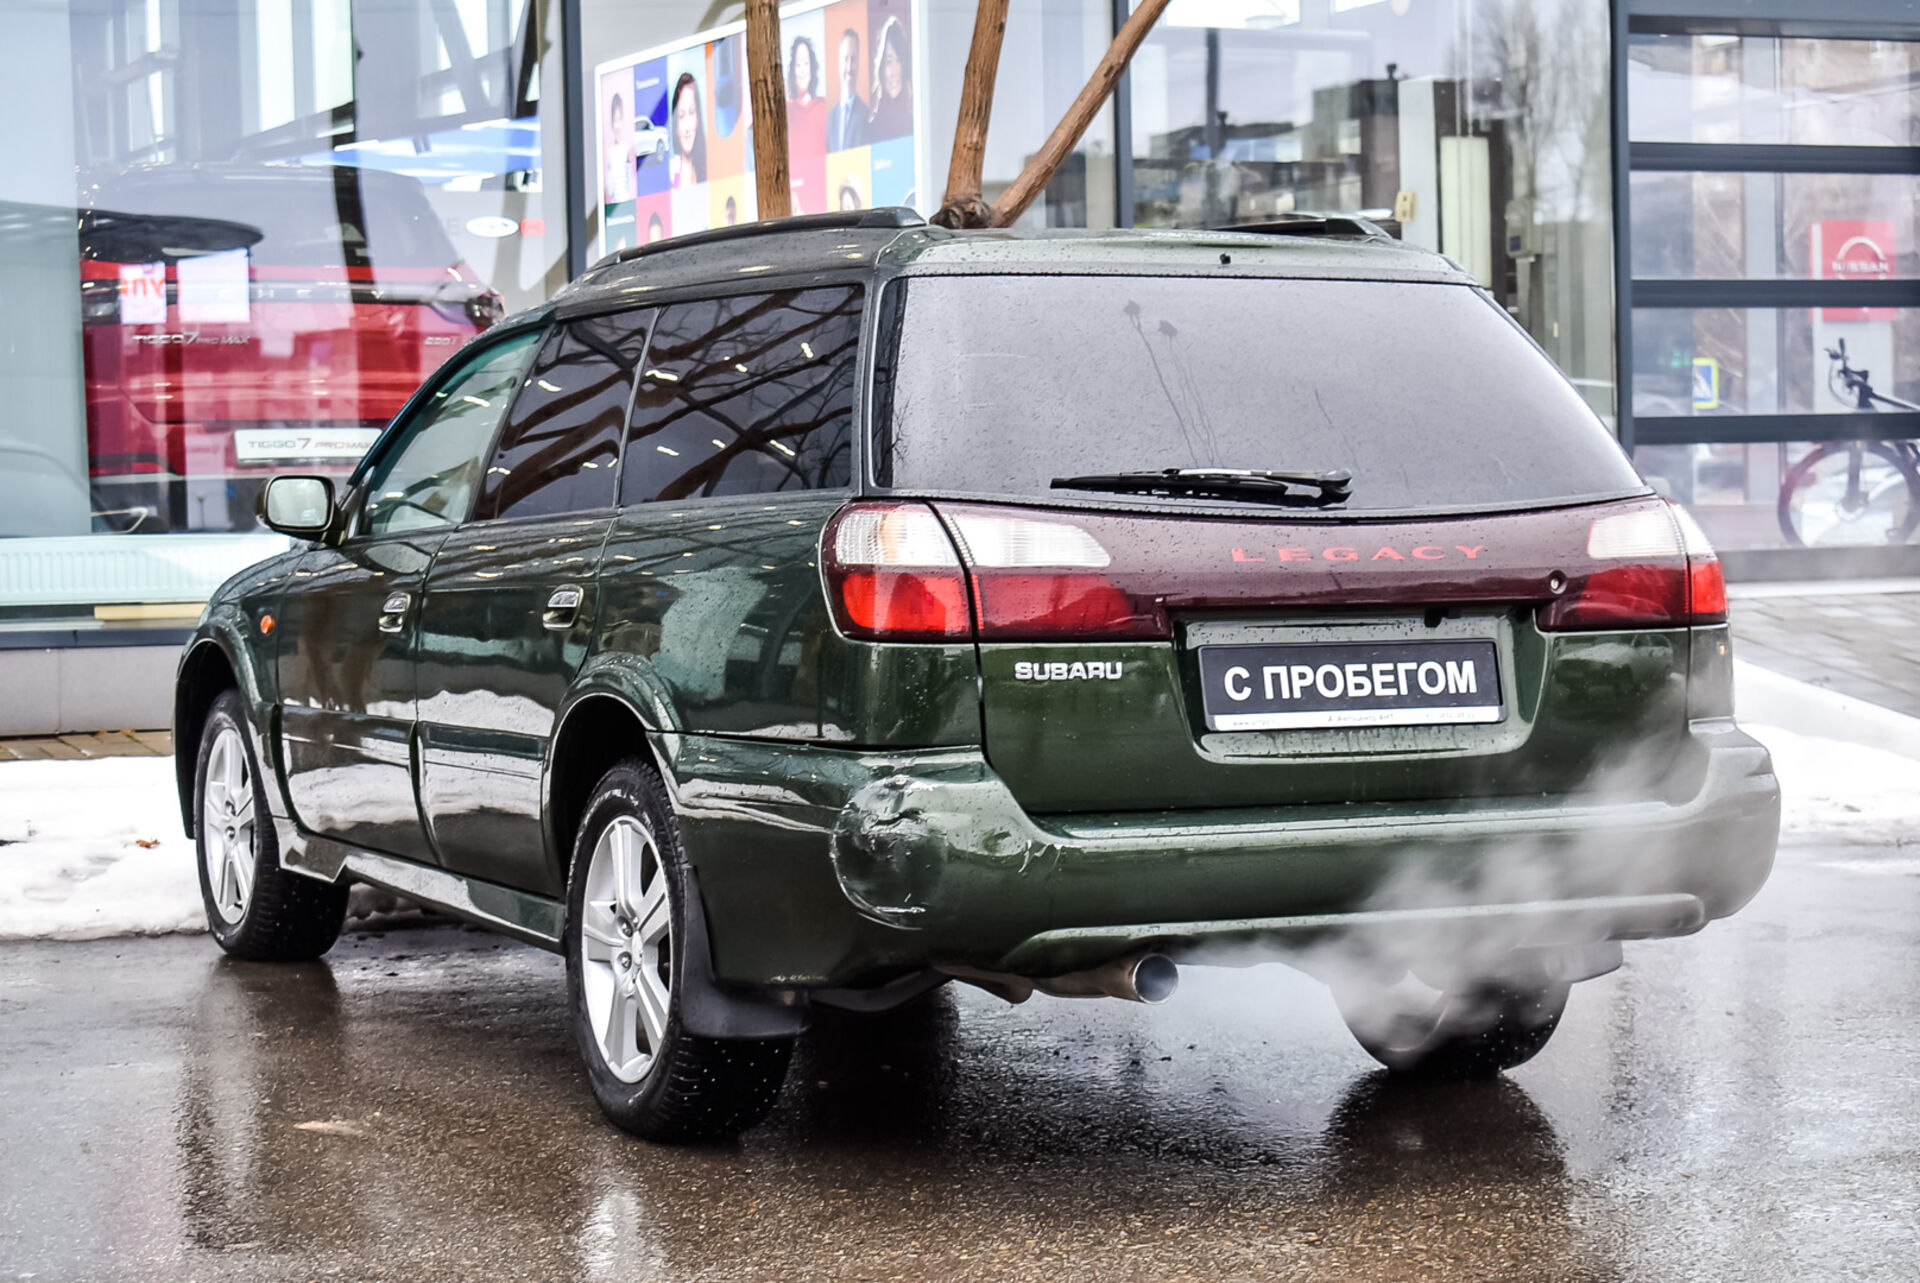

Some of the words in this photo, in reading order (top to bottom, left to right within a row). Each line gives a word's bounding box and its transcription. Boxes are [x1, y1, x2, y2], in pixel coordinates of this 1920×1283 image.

[1832, 260, 1889, 273] NISSAN
[1231, 545, 1484, 563] LEGACY
[1014, 661, 1123, 681] SUBARU
[1224, 666, 1252, 701] С
[1262, 660, 1478, 700] ПРОБЕГОМ
